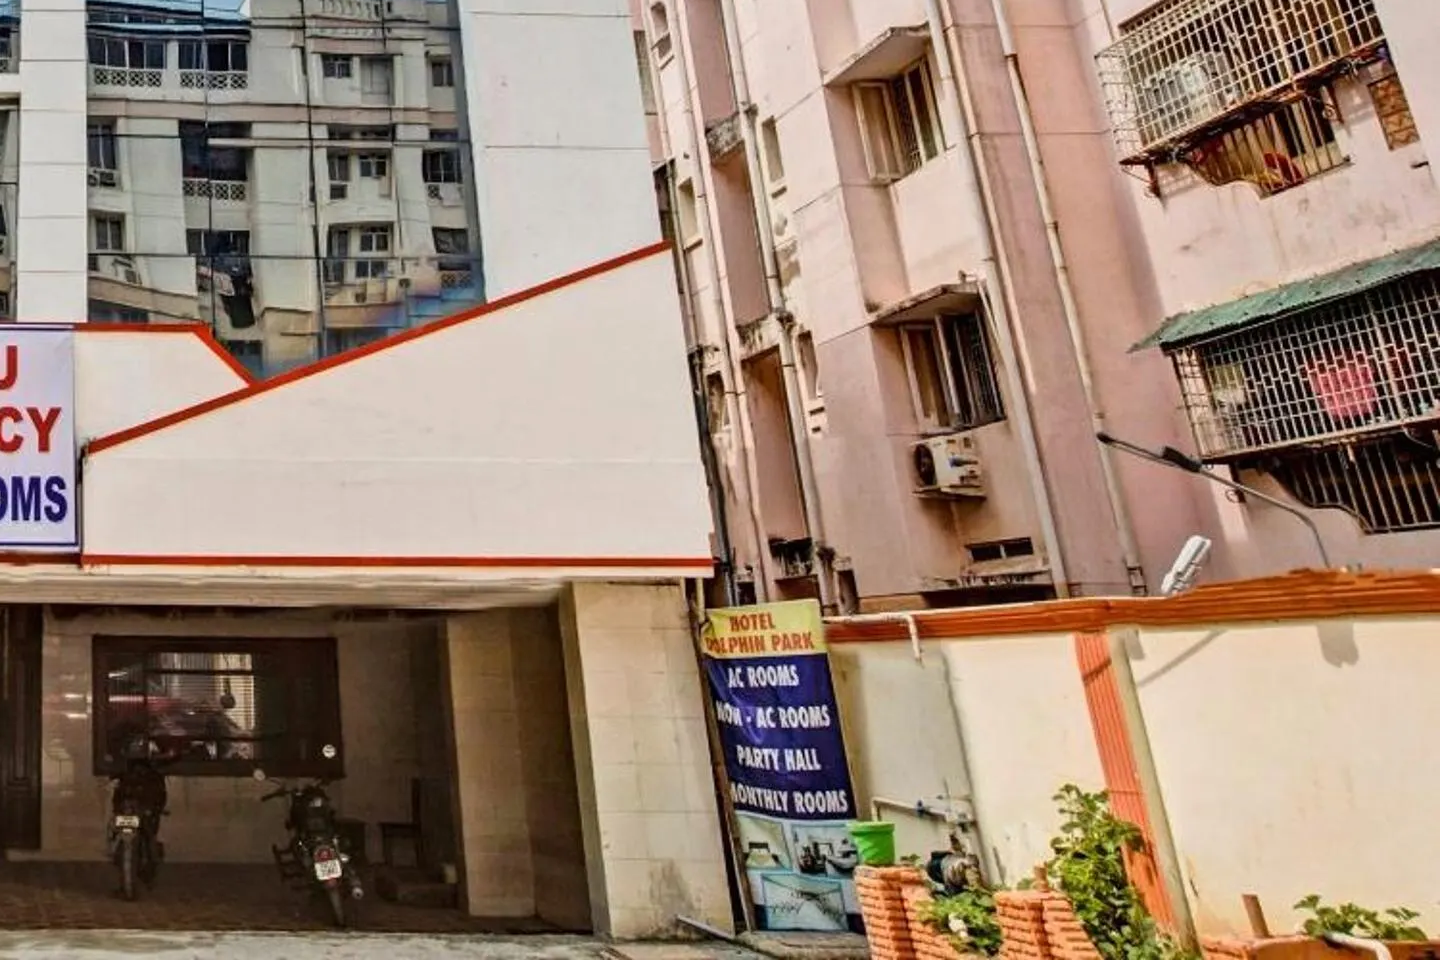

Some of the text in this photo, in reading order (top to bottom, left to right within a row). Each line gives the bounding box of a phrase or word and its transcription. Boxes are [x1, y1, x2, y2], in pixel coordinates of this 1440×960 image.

[729, 611, 776, 632] HOTEL
[771, 632, 815, 651] PARK
[728, 664, 800, 688] AC ROOMS
[756, 706, 777, 729] AC
[778, 704, 831, 728] ROOMS
[736, 744, 822, 771] PARTY HALL
[793, 789, 848, 813] ROOMS
